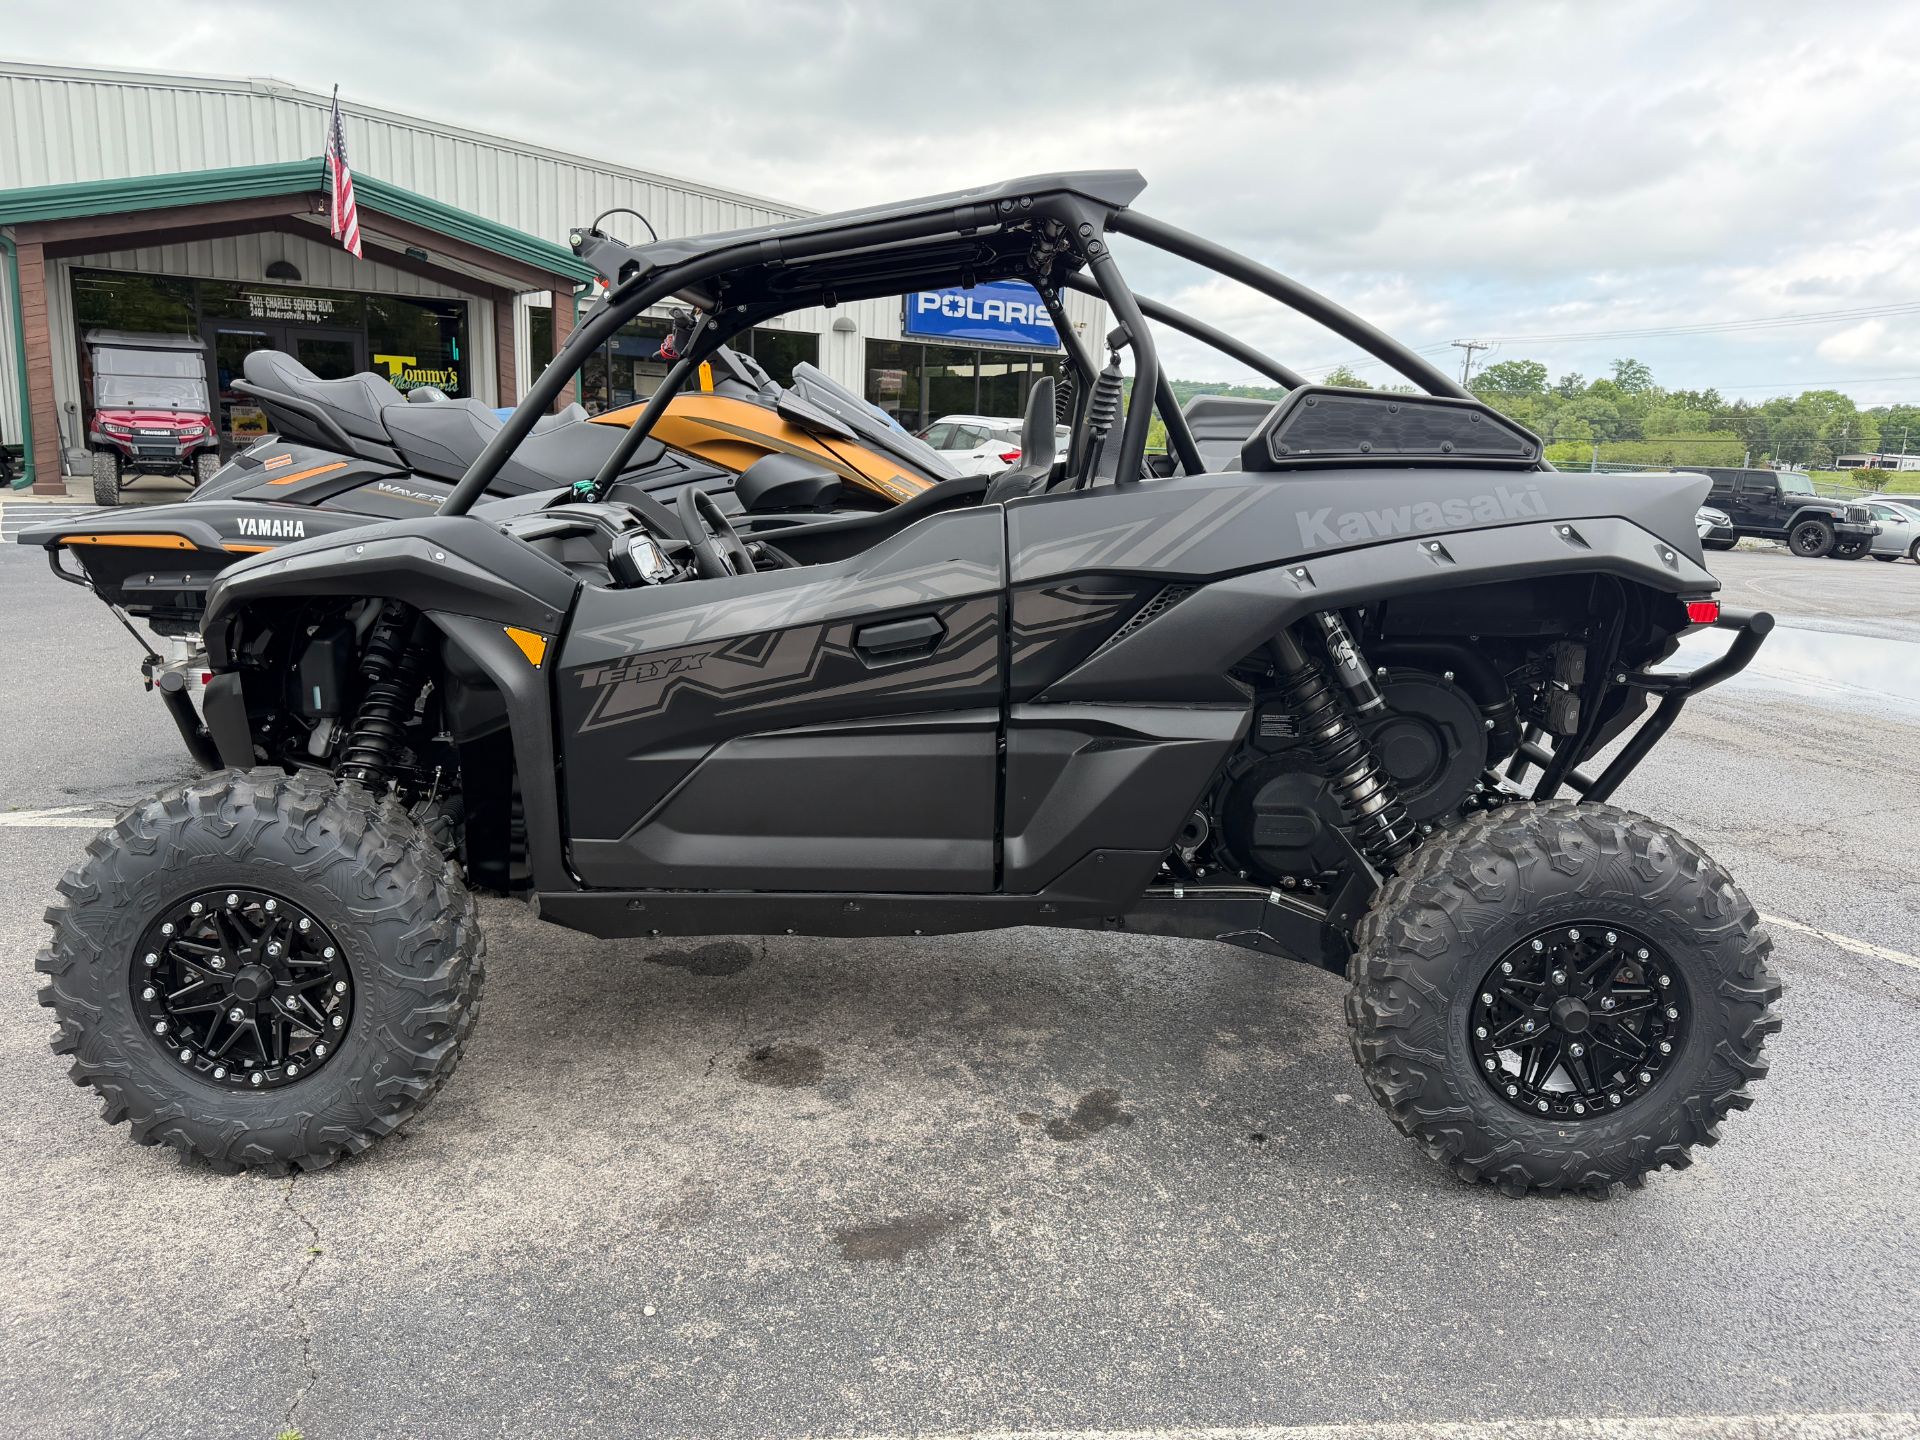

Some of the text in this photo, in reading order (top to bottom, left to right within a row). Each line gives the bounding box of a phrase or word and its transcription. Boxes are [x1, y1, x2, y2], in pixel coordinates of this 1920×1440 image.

[249, 296, 263, 308] 2401
[265, 297, 292, 309] CHARLES
[318, 301, 335, 313] BLVD.
[266, 309, 305, 320] Andersonville
[917, 292, 1054, 327] POLARIS
[374, 354, 458, 384] Tommy's
[237, 518, 305, 537] YAMAHA
[1295, 484, 1549, 549] Kawasaki
[574, 651, 710, 688] TERYX
